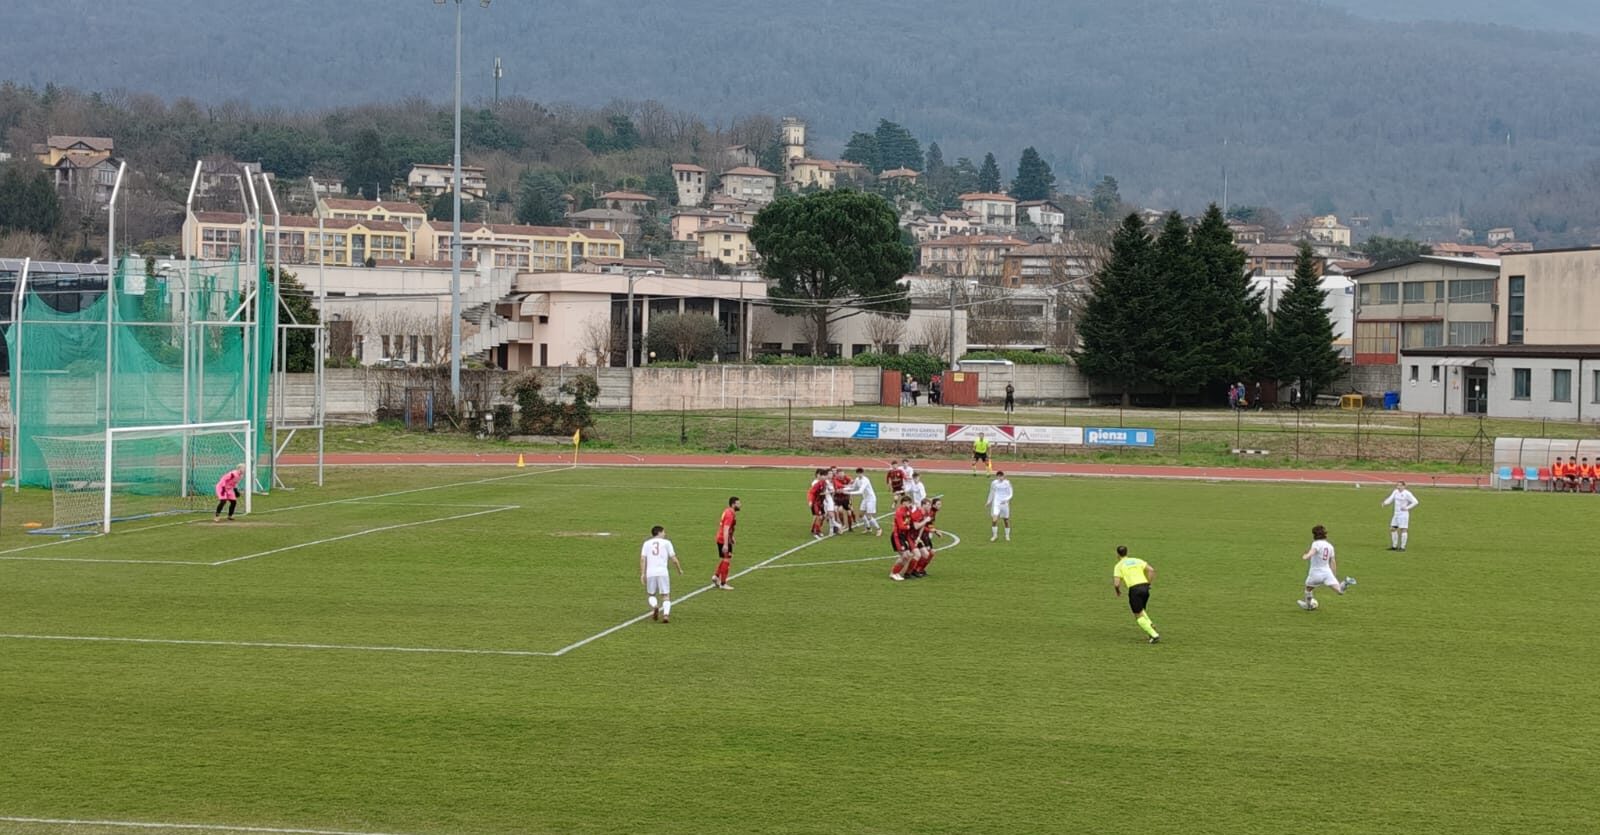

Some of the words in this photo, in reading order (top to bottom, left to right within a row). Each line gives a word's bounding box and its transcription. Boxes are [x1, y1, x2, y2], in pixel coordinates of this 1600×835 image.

[1088, 429, 1127, 443] Rienzi
[652, 541, 660, 556] 3
[1323, 547, 1329, 561] 9
